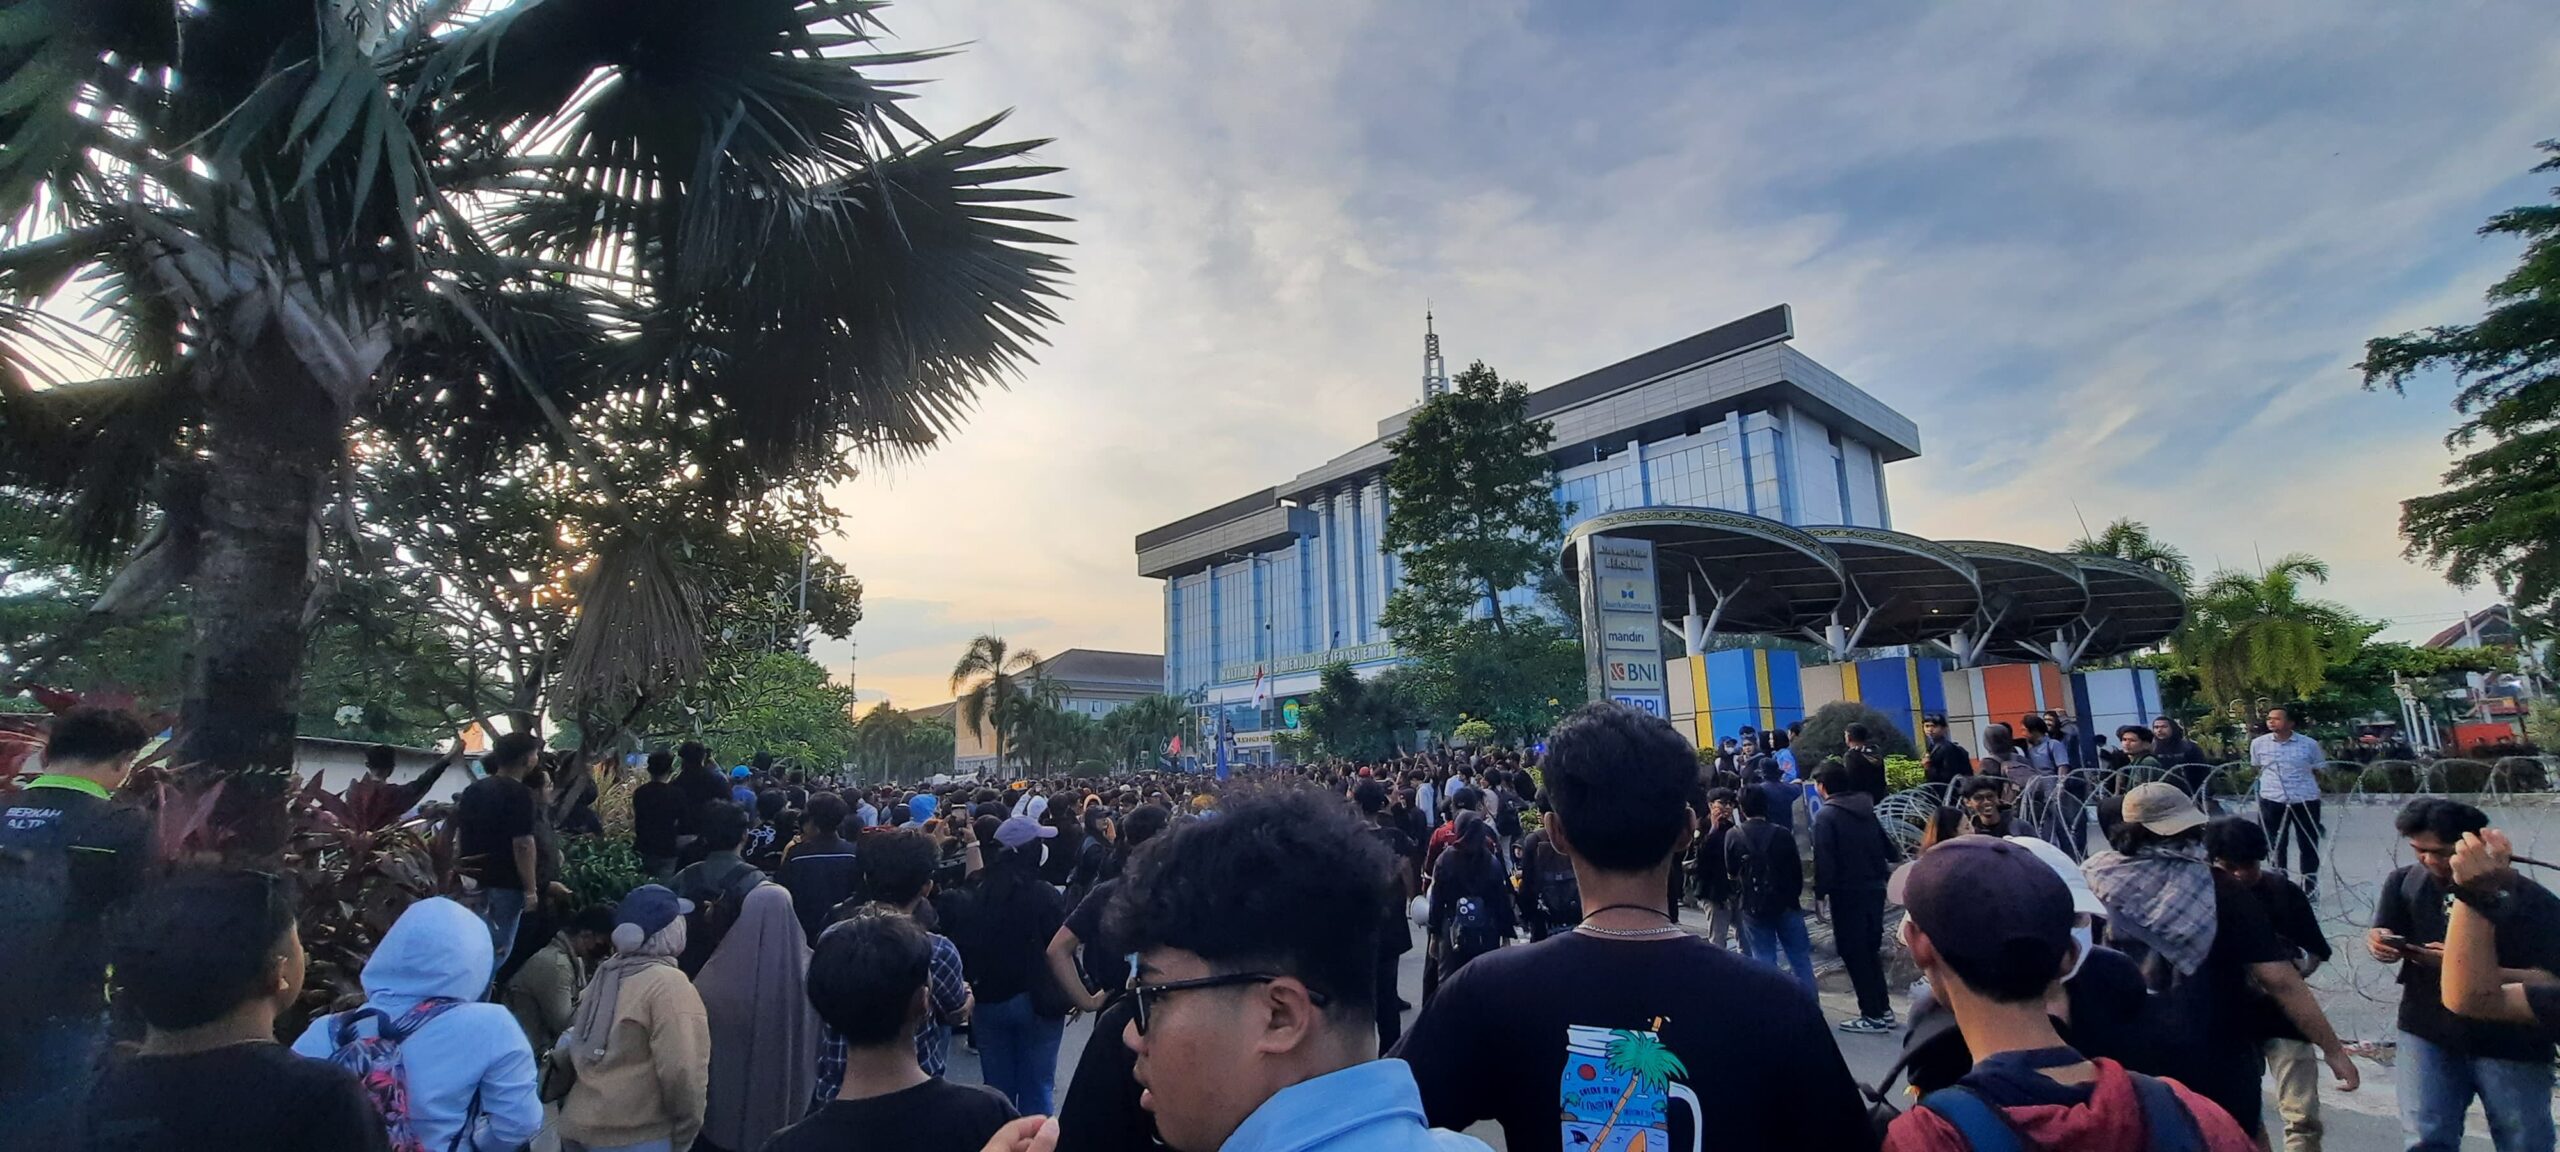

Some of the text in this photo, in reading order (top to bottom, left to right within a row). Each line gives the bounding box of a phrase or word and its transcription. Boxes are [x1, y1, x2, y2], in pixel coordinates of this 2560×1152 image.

[1608, 631, 1644, 642] mandiri
[1249, 662, 1280, 677] SUSS
[1363, 643, 1390, 659] EMAS
[1628, 663, 1657, 681] BNI
